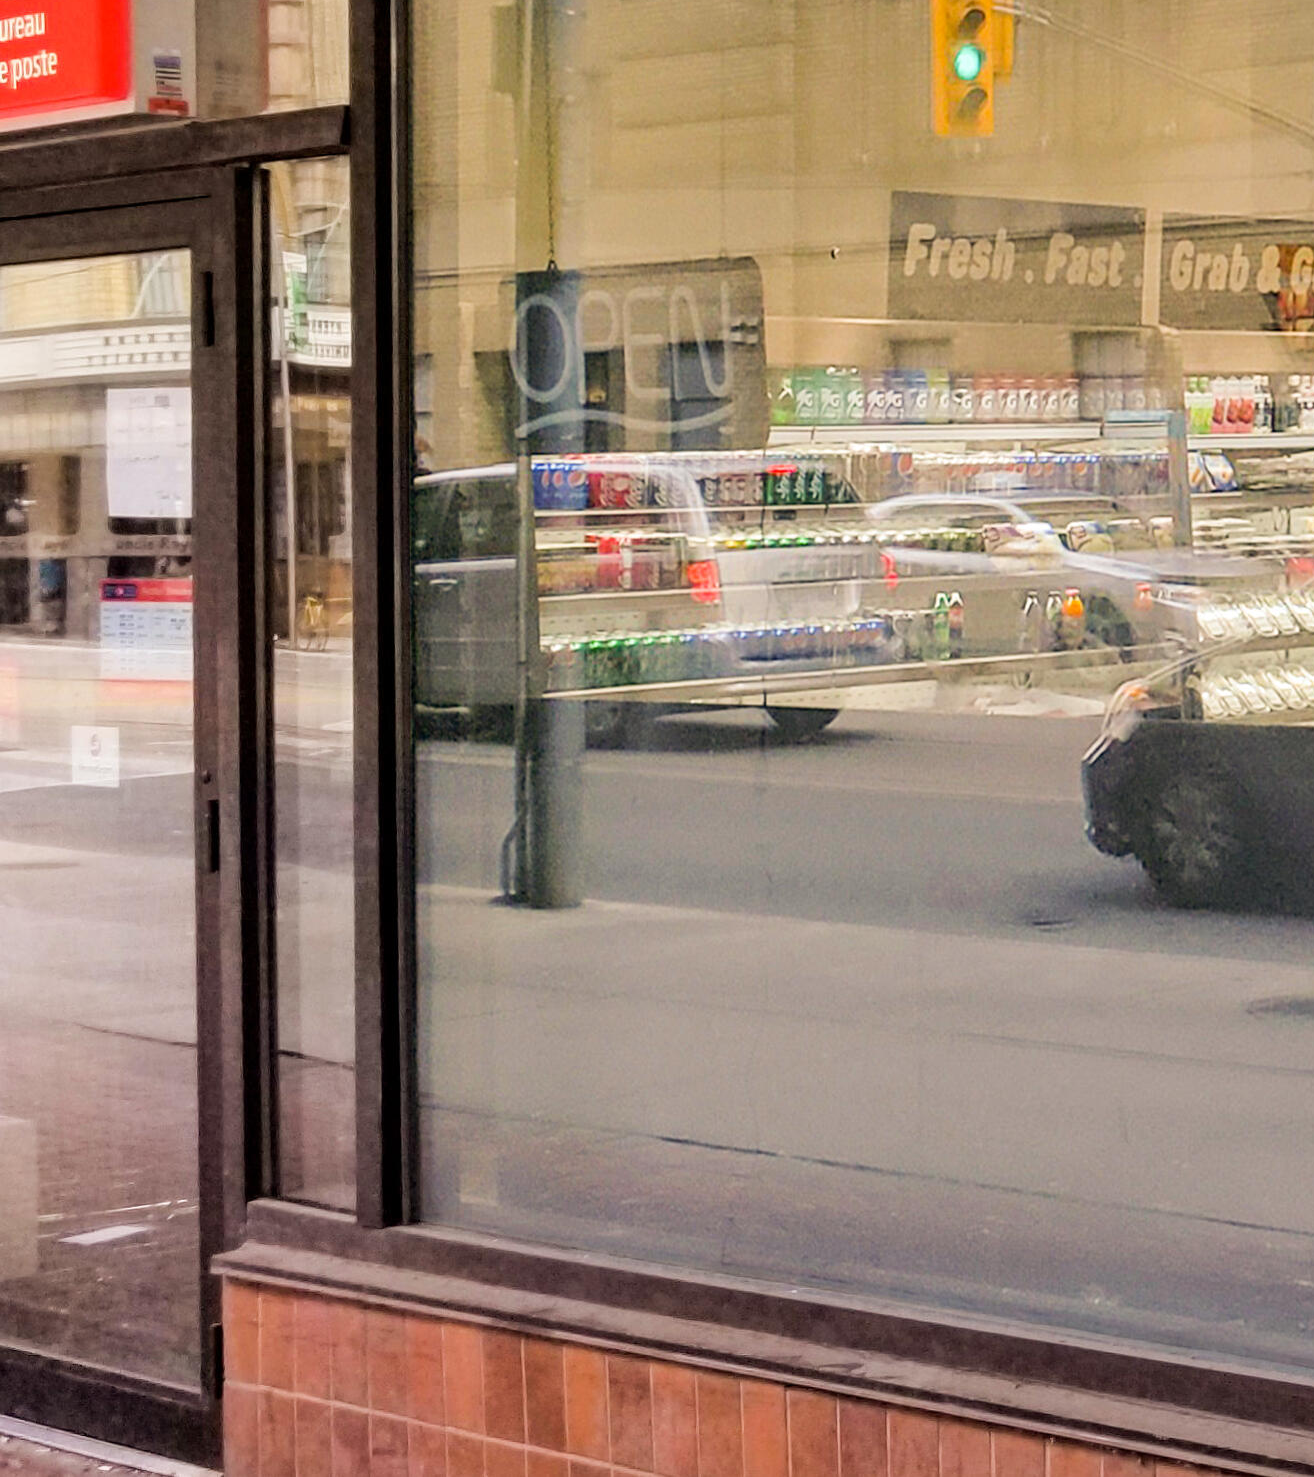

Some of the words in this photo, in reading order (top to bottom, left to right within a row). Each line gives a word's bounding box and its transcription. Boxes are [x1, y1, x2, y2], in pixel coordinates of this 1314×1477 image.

[11, 49, 58, 90] poste
[1170, 239, 1250, 293] Grab
[1257, 245, 1281, 294] &
[509, 281, 735, 405] OPEN
